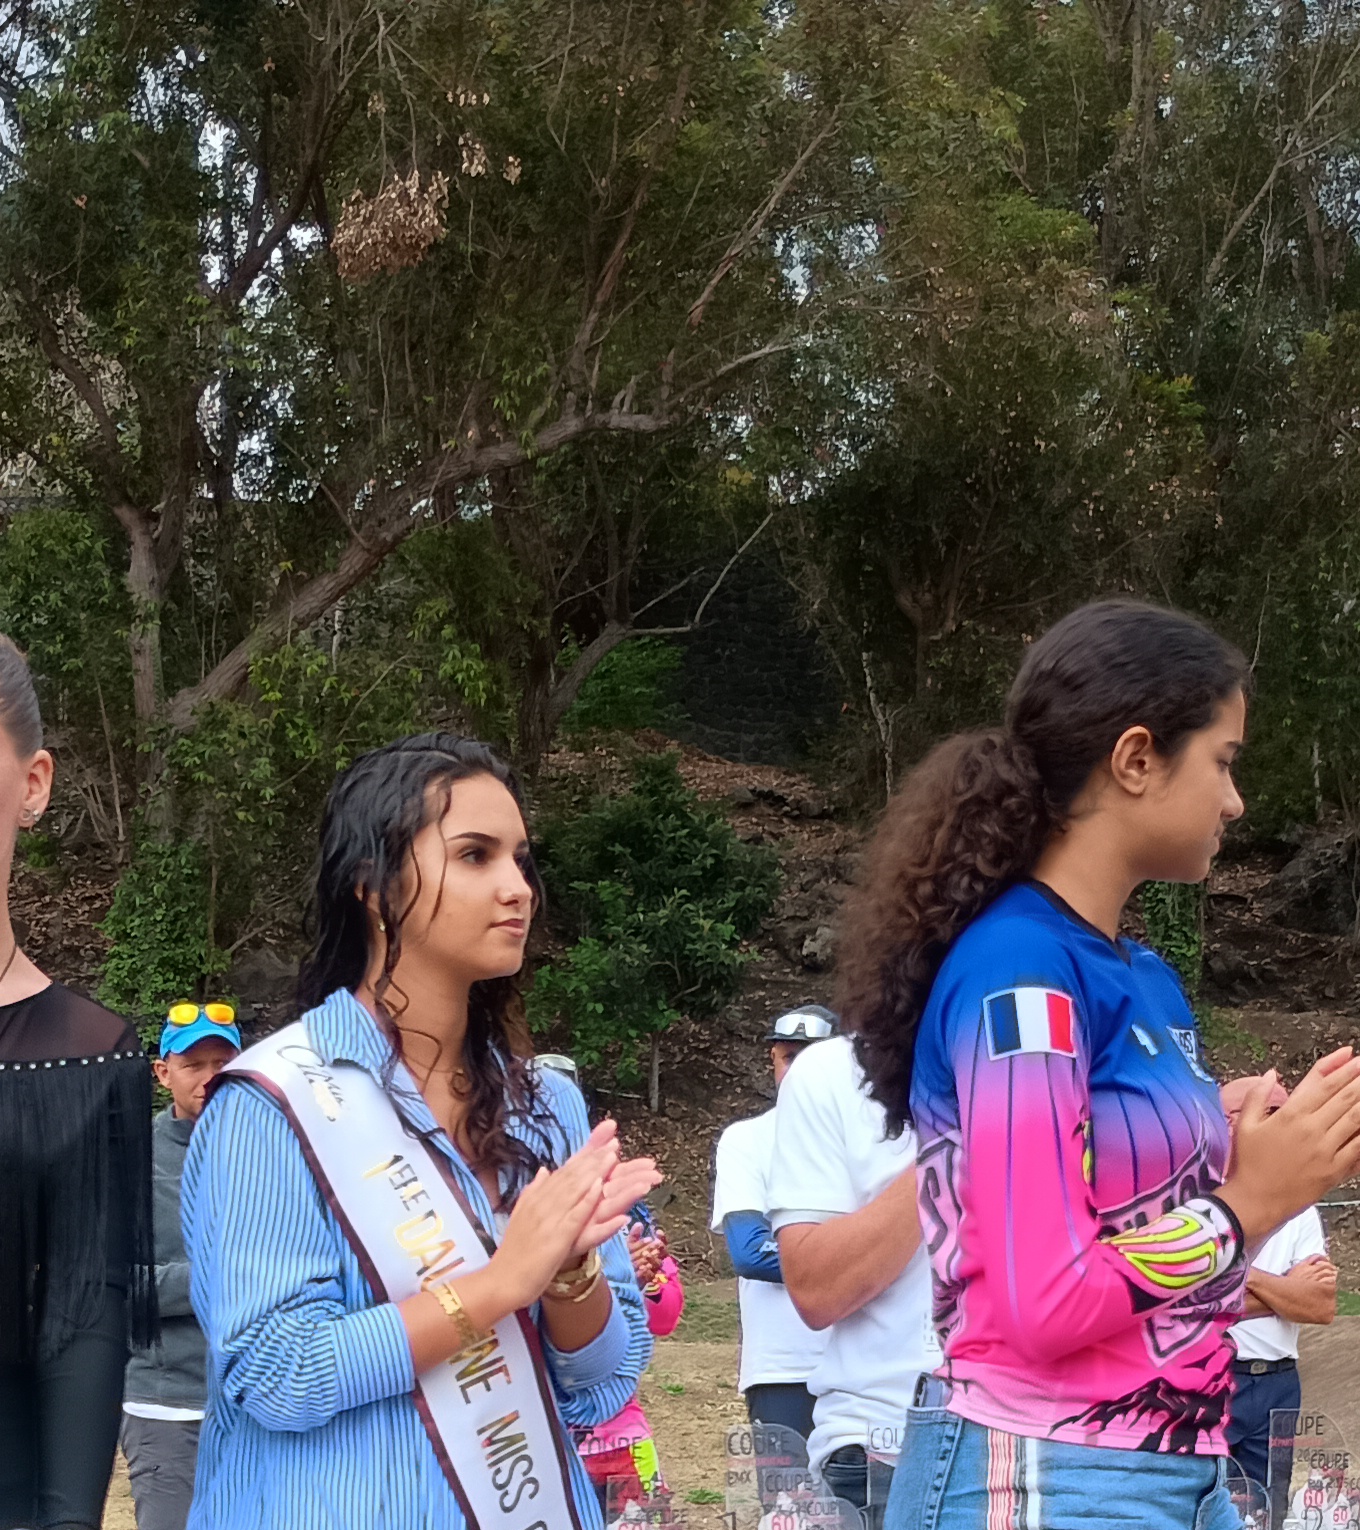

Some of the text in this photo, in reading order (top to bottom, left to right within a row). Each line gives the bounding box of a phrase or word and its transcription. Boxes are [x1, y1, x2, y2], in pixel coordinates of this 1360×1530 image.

[394, 1208, 513, 1405] DAUNE
[475, 1409, 540, 1514] MISS
[870, 1427, 903, 1451] COU
[1303, 1488, 1324, 1508] 60
